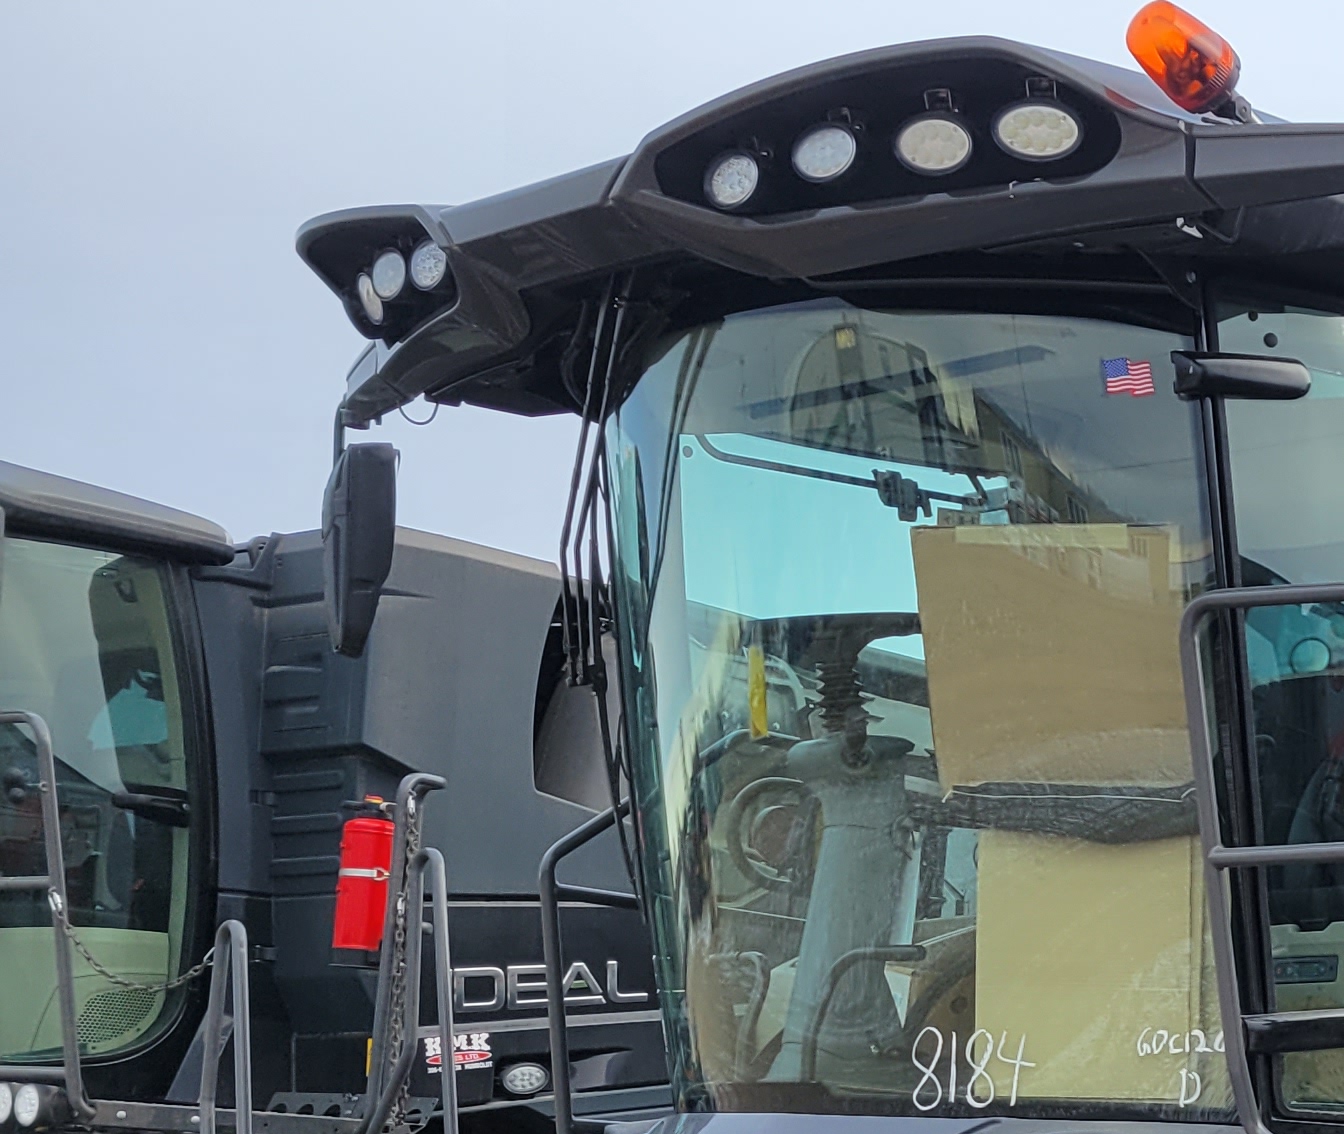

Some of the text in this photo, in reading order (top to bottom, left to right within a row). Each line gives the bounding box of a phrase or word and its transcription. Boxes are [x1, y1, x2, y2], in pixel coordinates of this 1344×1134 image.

[450, 960, 648, 1013] DEAL
[912, 1026, 1036, 1111] 8184
[1179, 1068, 1201, 1108] D
